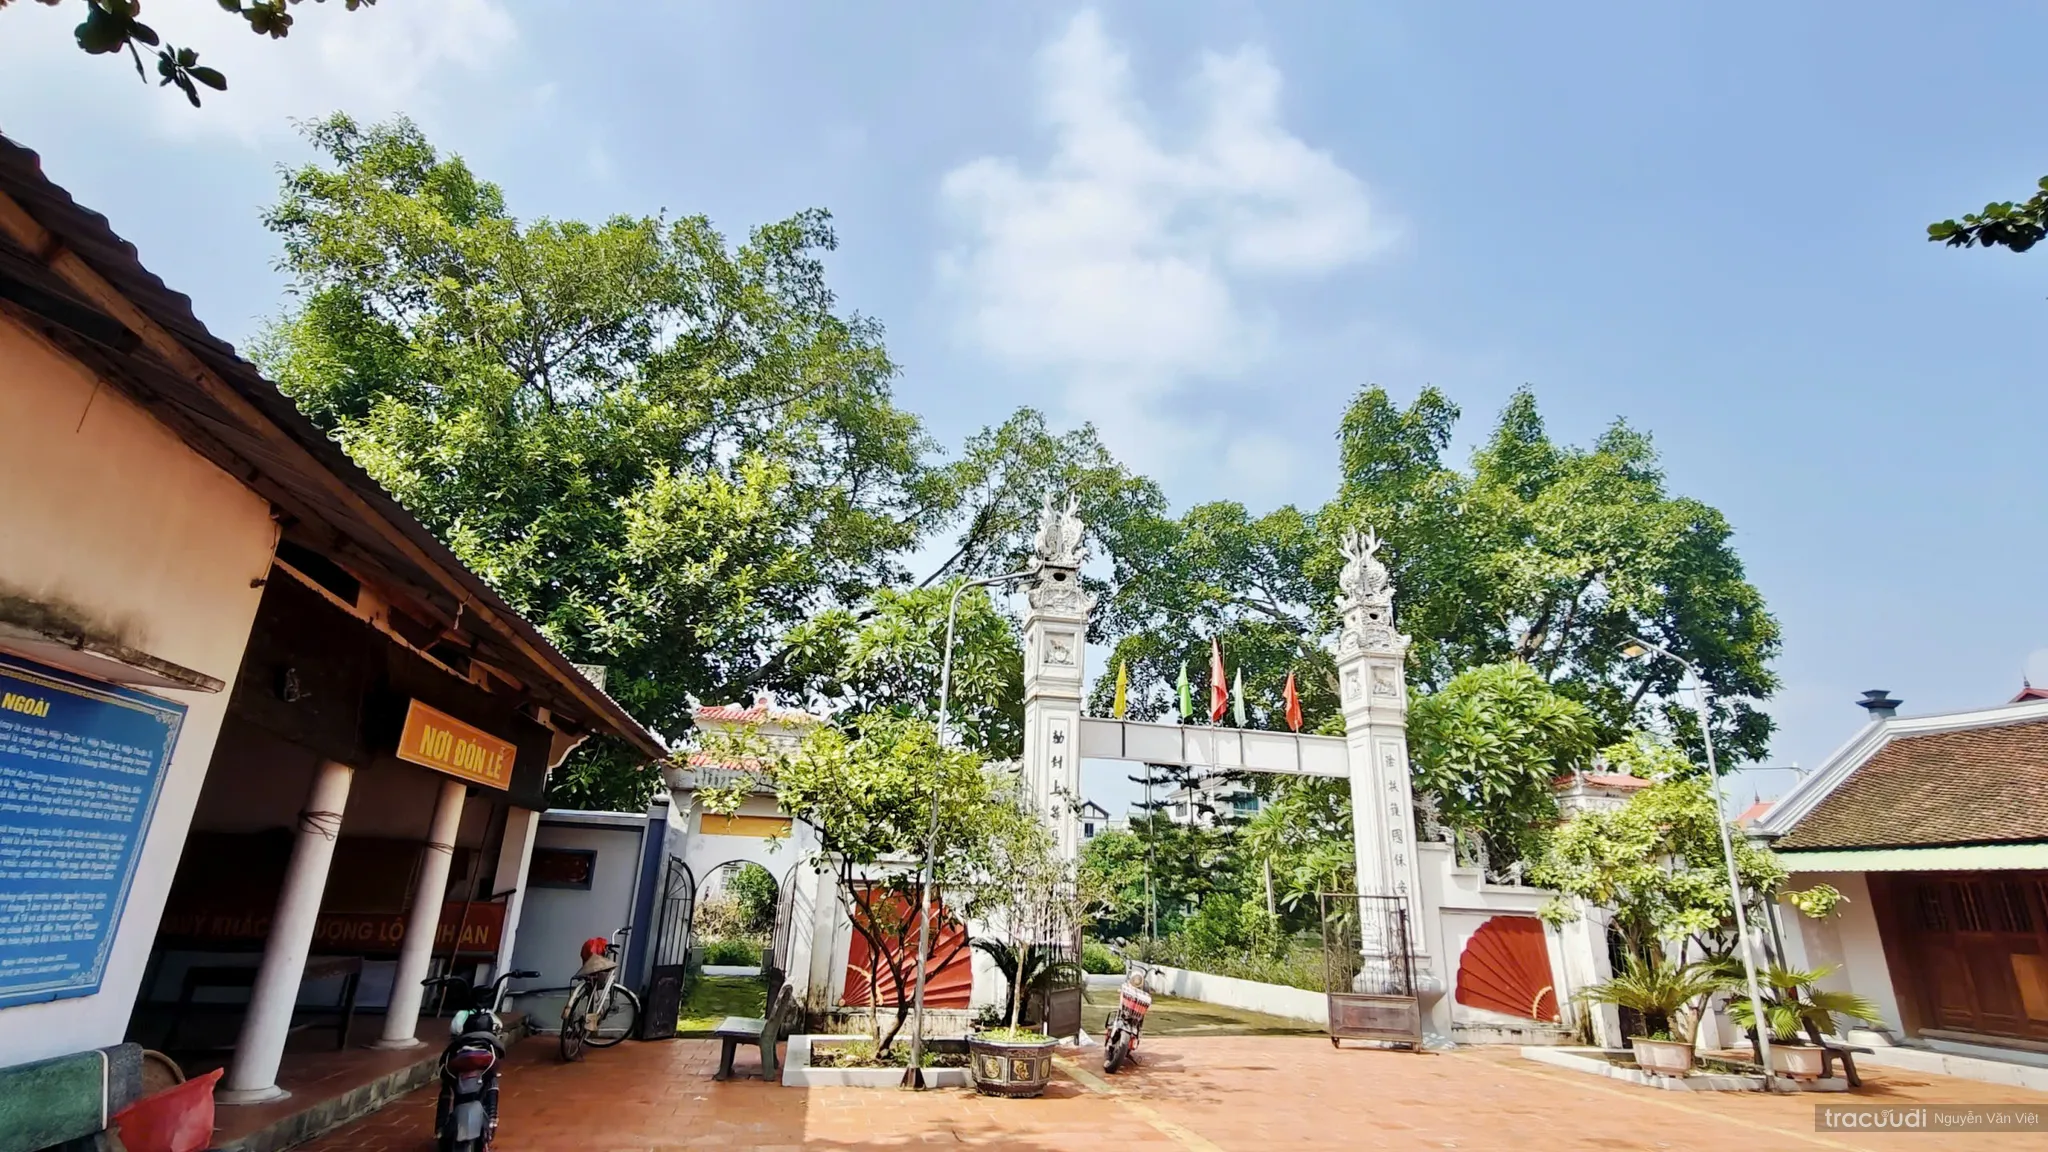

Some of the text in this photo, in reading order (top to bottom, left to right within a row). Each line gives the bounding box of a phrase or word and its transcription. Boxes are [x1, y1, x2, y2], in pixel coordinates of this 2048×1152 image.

[1, 692, 51, 718] NGOÀI
[419, 725, 505, 780] NƠI ĐÓN LỄ
[211, 910, 271, 939] KHÁC
[460, 924, 489, 944] AN
